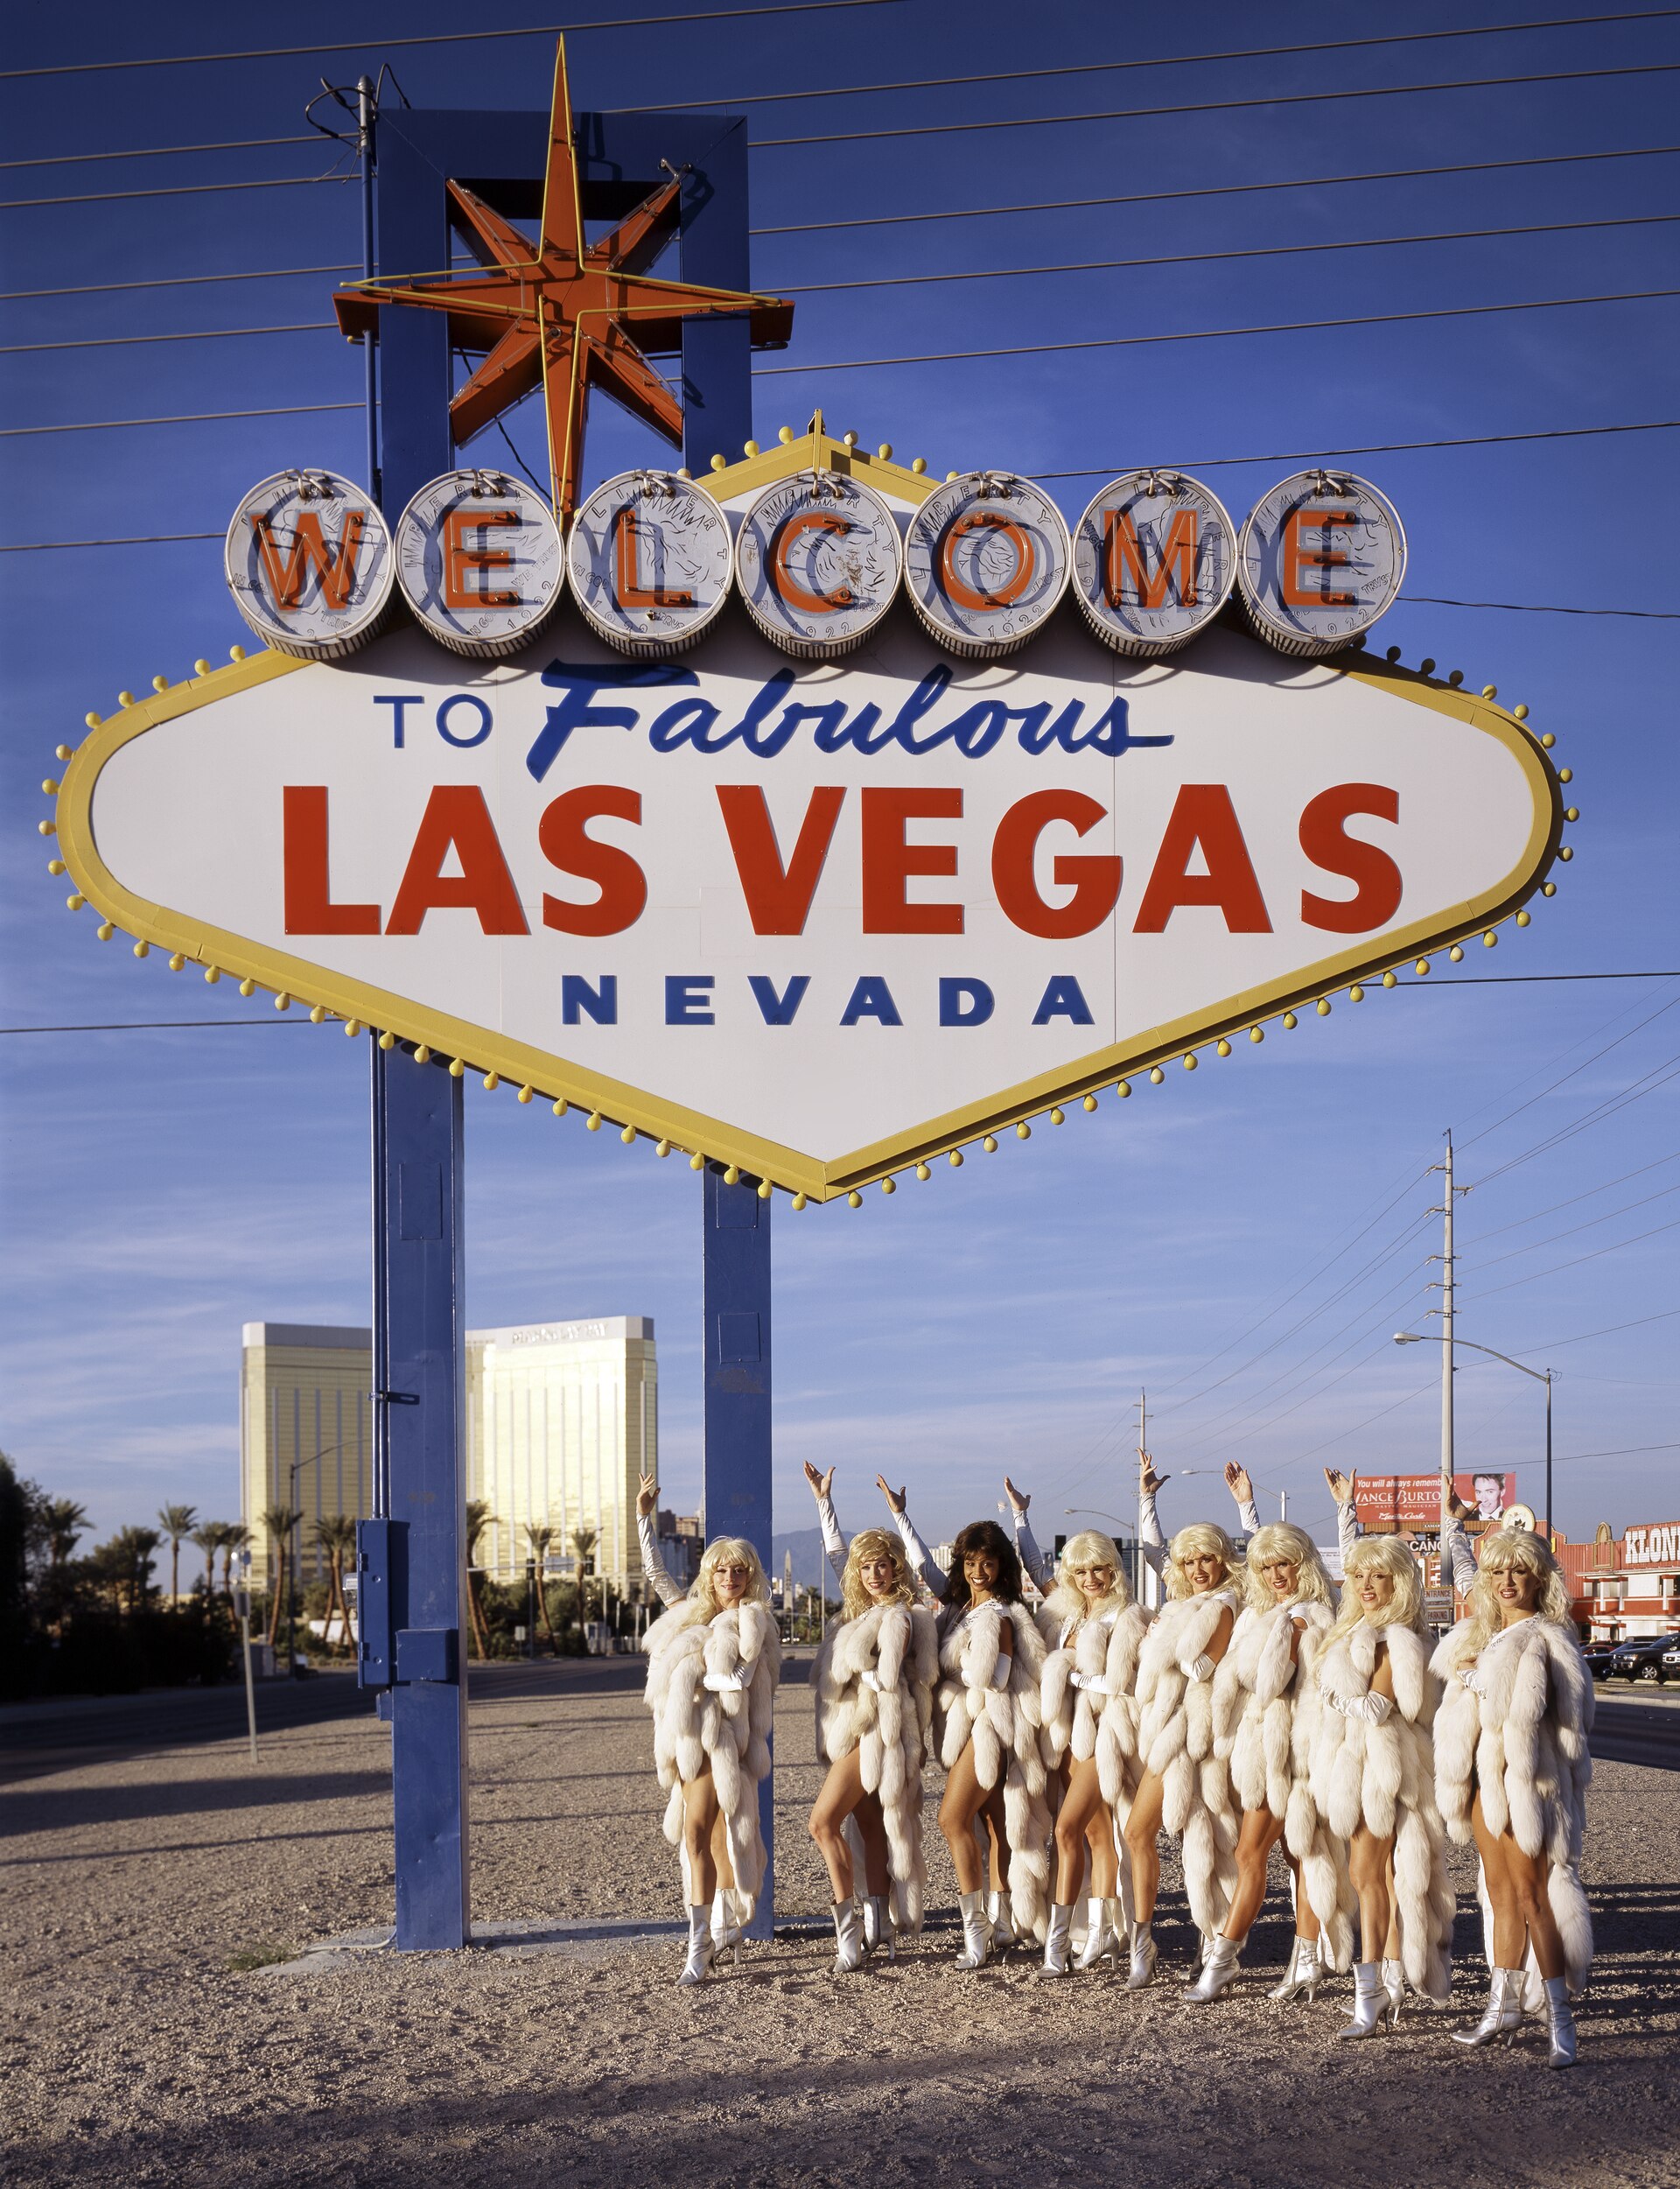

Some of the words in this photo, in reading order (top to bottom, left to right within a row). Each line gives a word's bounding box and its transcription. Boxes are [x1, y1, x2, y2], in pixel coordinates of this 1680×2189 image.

[246, 508, 1363, 614] WELCOME
[404, 484, 528, 607] LIBERY
[479, 611, 496, 628] GO
[770, 600, 786, 612] GO
[986, 603, 1046, 638] 1922
[790, 621, 853, 638] 1922
[374, 695, 494, 748] TO
[526, 660, 1173, 782] Fabulous
[284, 783, 648, 937] LAS
[715, 782, 1402, 940] VEGAS
[562, 976, 1094, 1026] NEVADA
[1355, 1490, 1394, 1506] LANCE
[1395, 1487, 1442, 1505] BURTO
[1357, 1479, 1370, 1488] You
[1372, 1478, 1385, 1487] will
[1388, 1478, 1411, 1489] always
[1625, 1526, 1680, 1564] KLON
